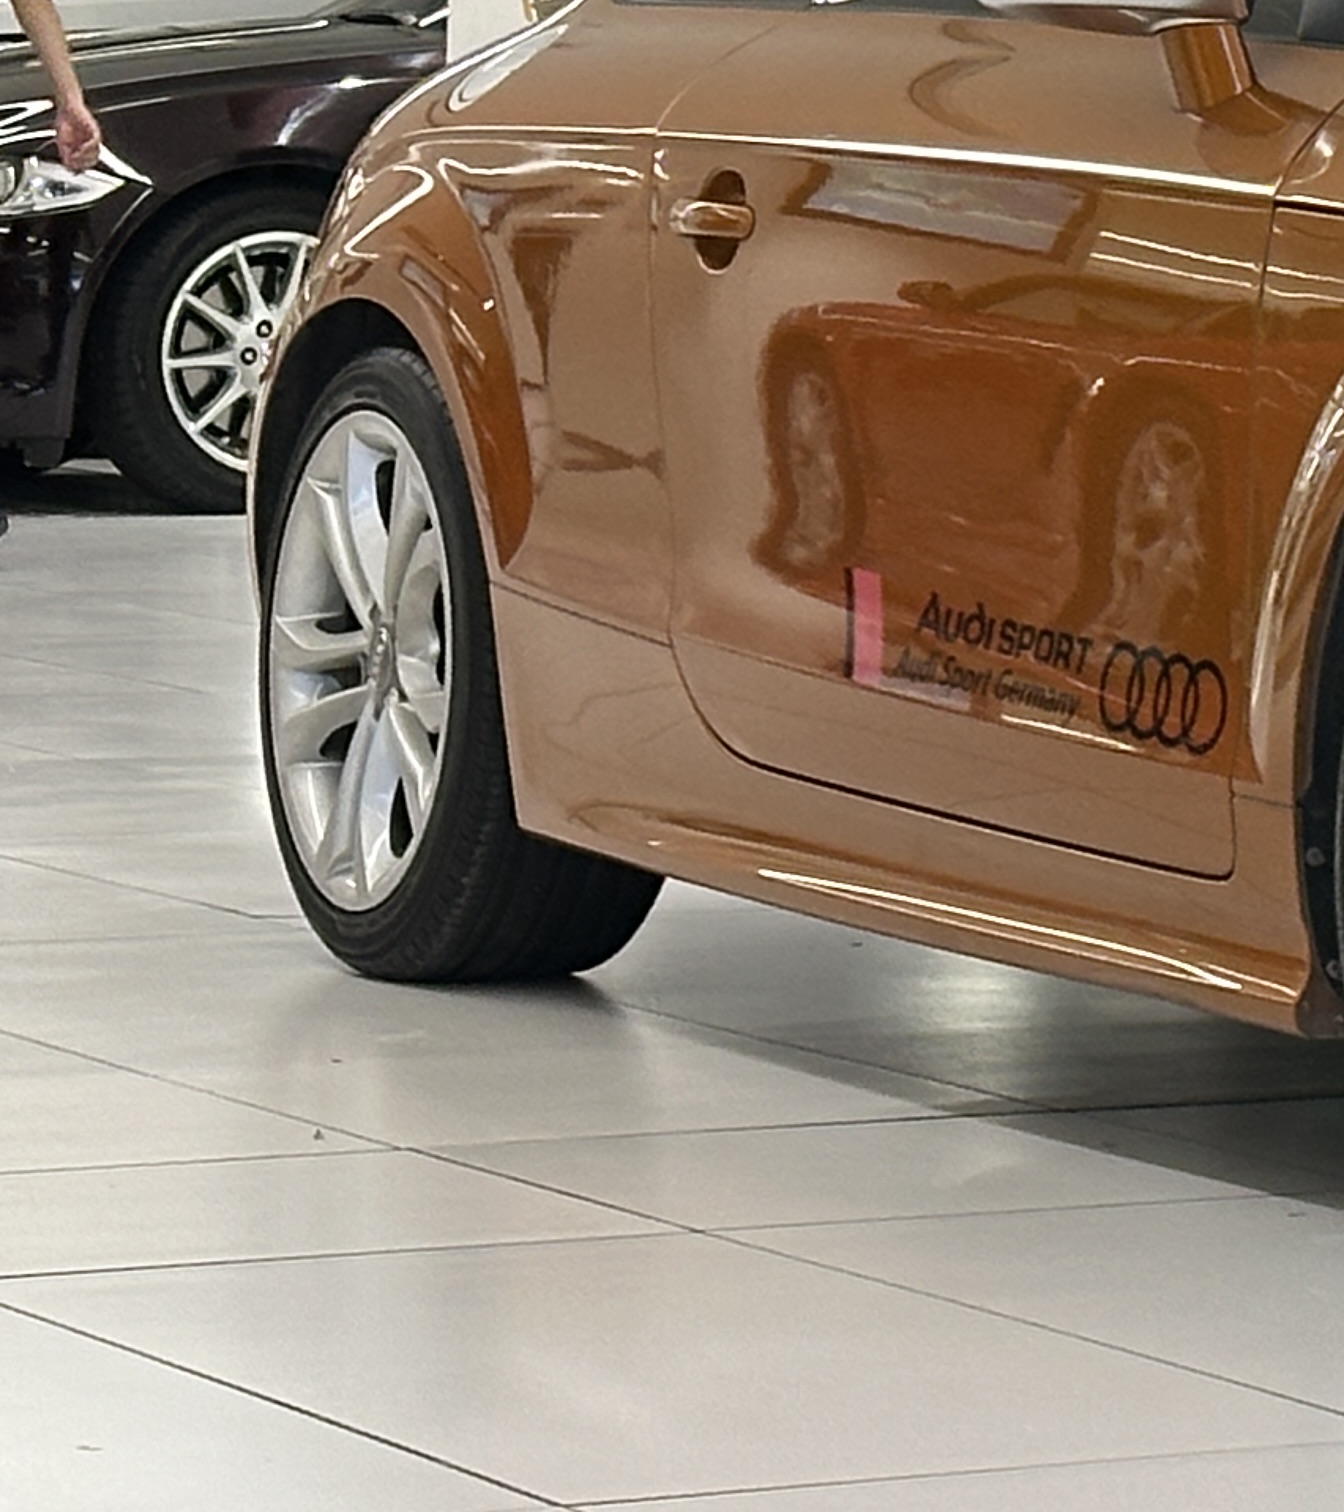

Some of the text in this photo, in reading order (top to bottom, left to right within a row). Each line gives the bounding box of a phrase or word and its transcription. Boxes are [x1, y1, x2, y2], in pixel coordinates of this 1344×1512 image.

[999, 618, 1094, 675] SPORT
[942, 655, 994, 696] Sport
[994, 668, 1081, 721] Germany
